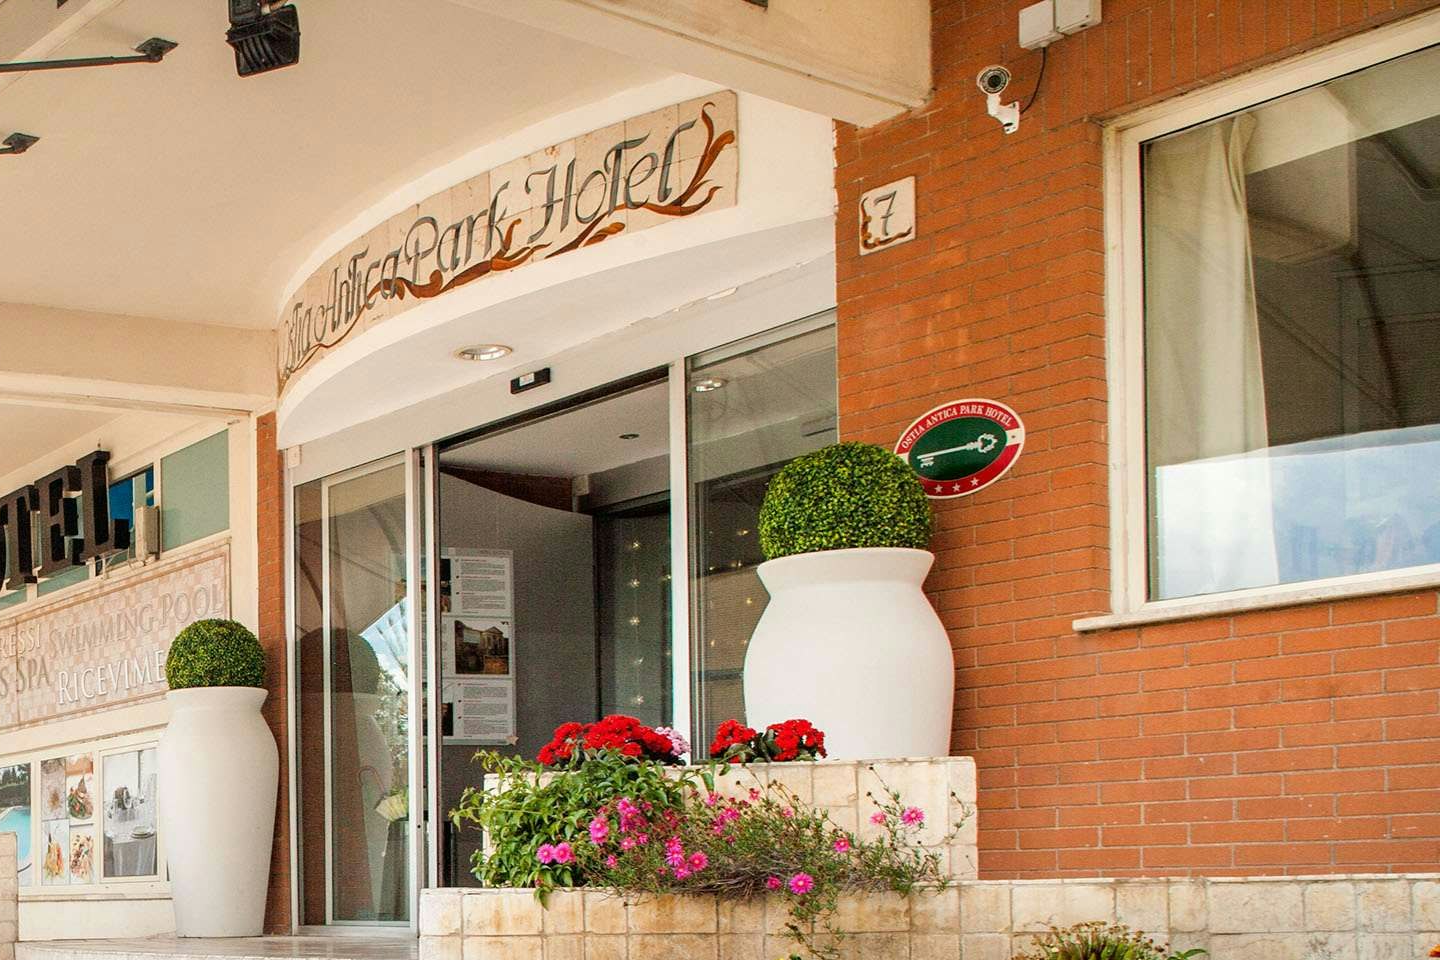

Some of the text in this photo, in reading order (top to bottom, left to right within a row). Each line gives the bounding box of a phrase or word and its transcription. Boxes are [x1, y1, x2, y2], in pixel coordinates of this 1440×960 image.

[405, 181, 510, 286] Park
[873, 190, 898, 237] 7
[901, 404, 1013, 449] OSTIA ANTICA PARK HOTEL
[49, 583, 223, 658] SWIMMING POOL
[17, 655, 52, 693] SPA
[59, 650, 167, 706] RICEVIME
